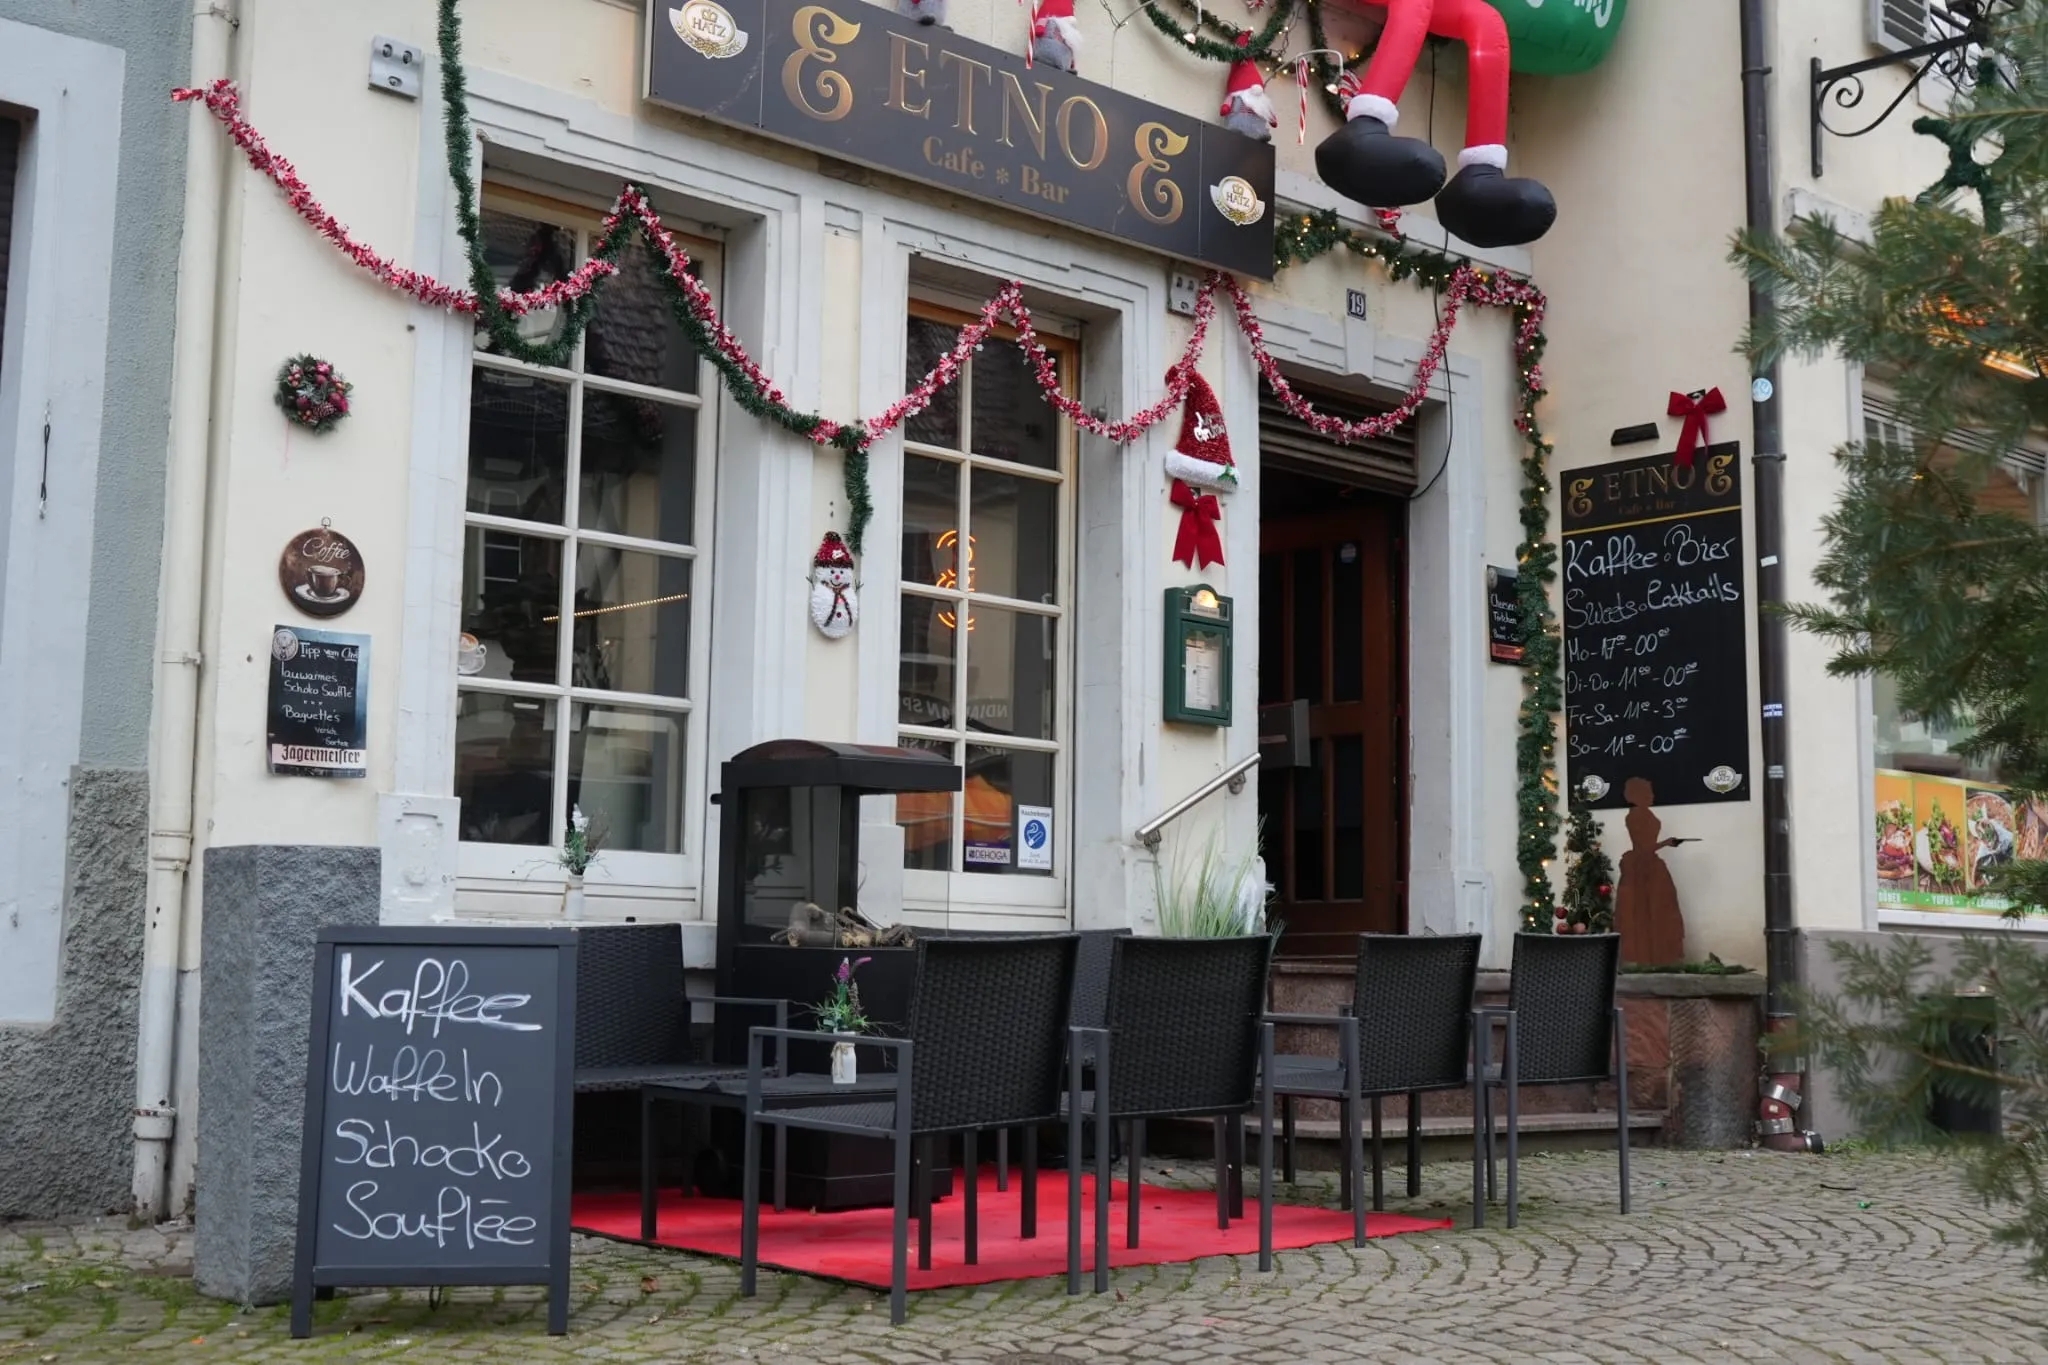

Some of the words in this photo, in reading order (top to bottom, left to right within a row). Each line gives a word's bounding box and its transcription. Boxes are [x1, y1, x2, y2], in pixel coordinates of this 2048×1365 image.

[691, 16, 727, 38] HATZ
[882, 30, 1109, 171] ETNO
[922, 135, 986, 180] Cafe
[1020, 163, 1070, 204] Bar
[1226, 191, 1251, 208] HATZ
[1350, 292, 1365, 316] 19
[1602, 463, 1696, 502] ETNO
[302, 536, 352, 563] Coffee
[1565, 534, 1660, 583] Kaffee
[1663, 523, 1737, 567] Bier
[340, 952, 543, 1039] Kaffee
[332, 1041, 503, 1107] Waffeln
